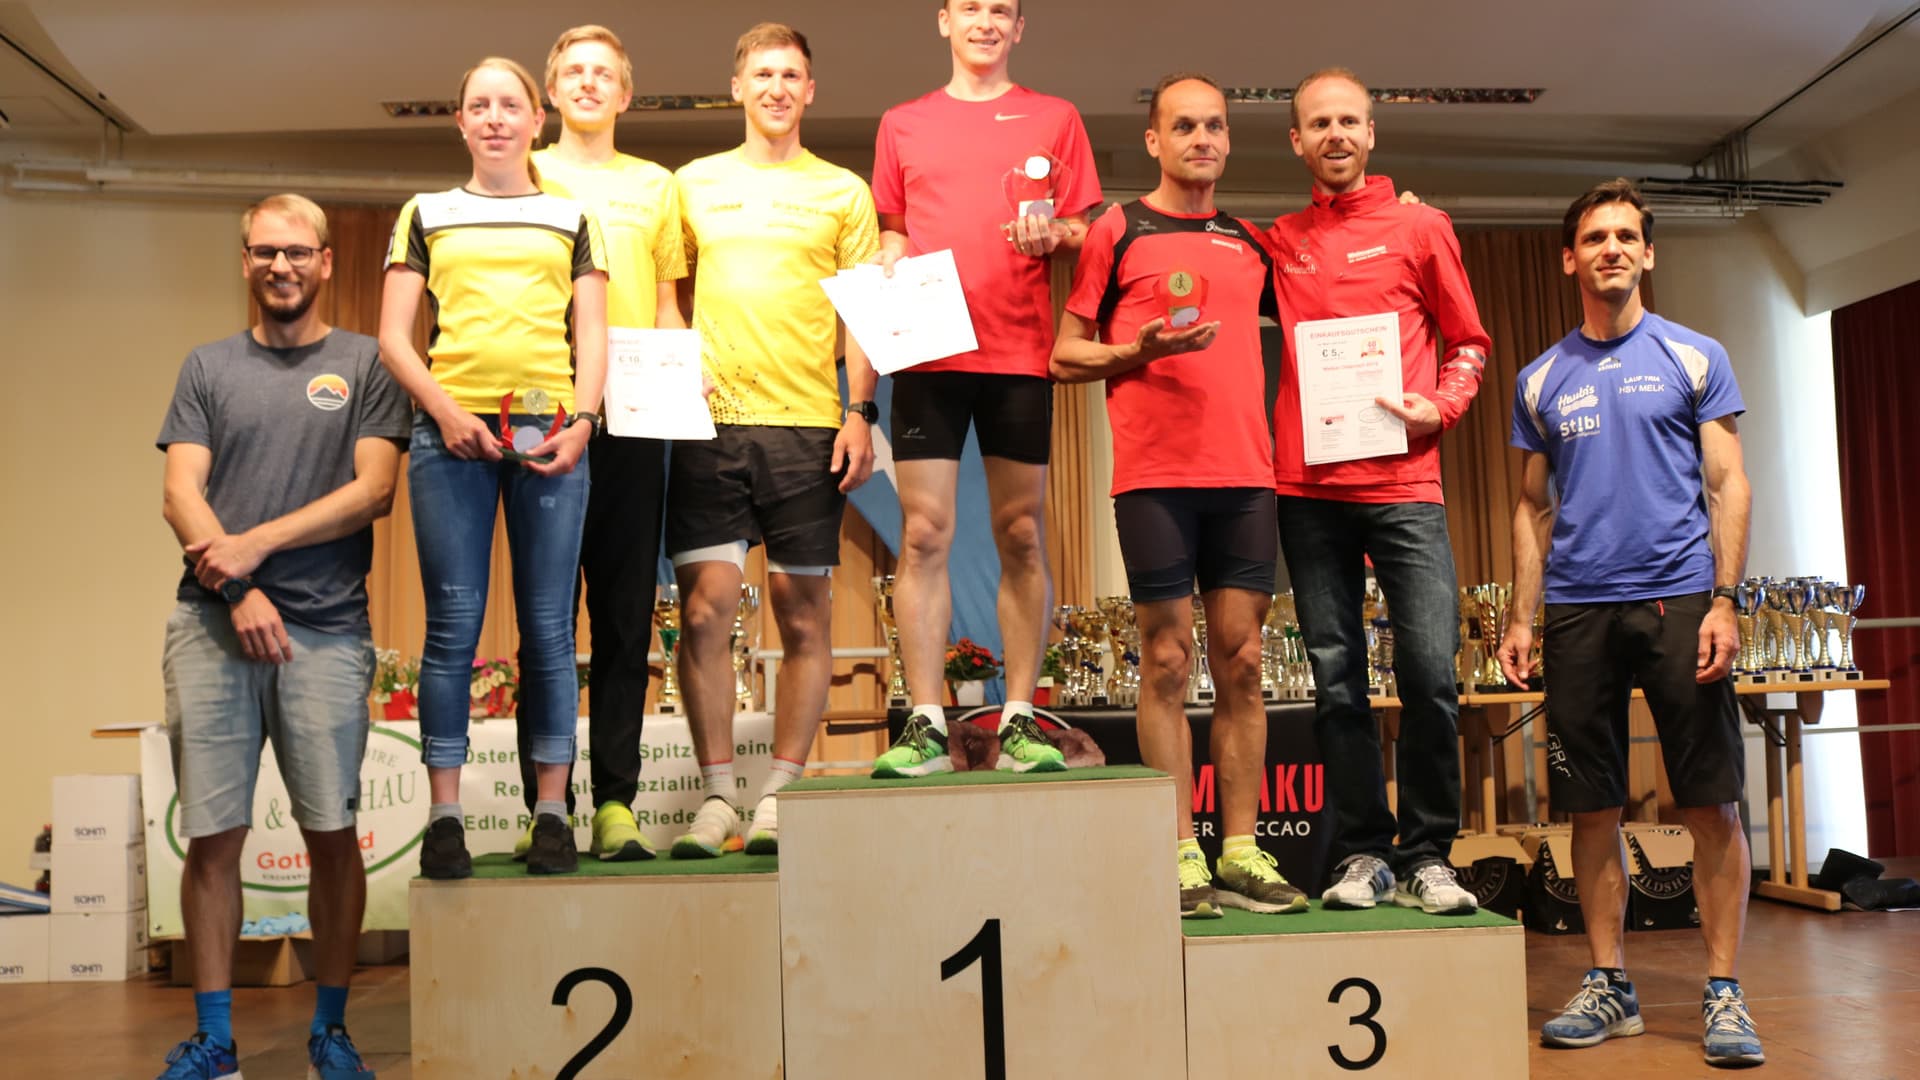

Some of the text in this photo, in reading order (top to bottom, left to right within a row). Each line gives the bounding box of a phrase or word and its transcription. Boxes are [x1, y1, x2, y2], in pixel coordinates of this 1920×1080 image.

[1618, 384, 1665, 394] HSV MELK
[264, 797, 286, 831] &
[464, 813, 509, 831] Edle
[551, 966, 633, 1080] 2
[940, 918, 1006, 1080] 1
[1327, 977, 1387, 1071] 3
